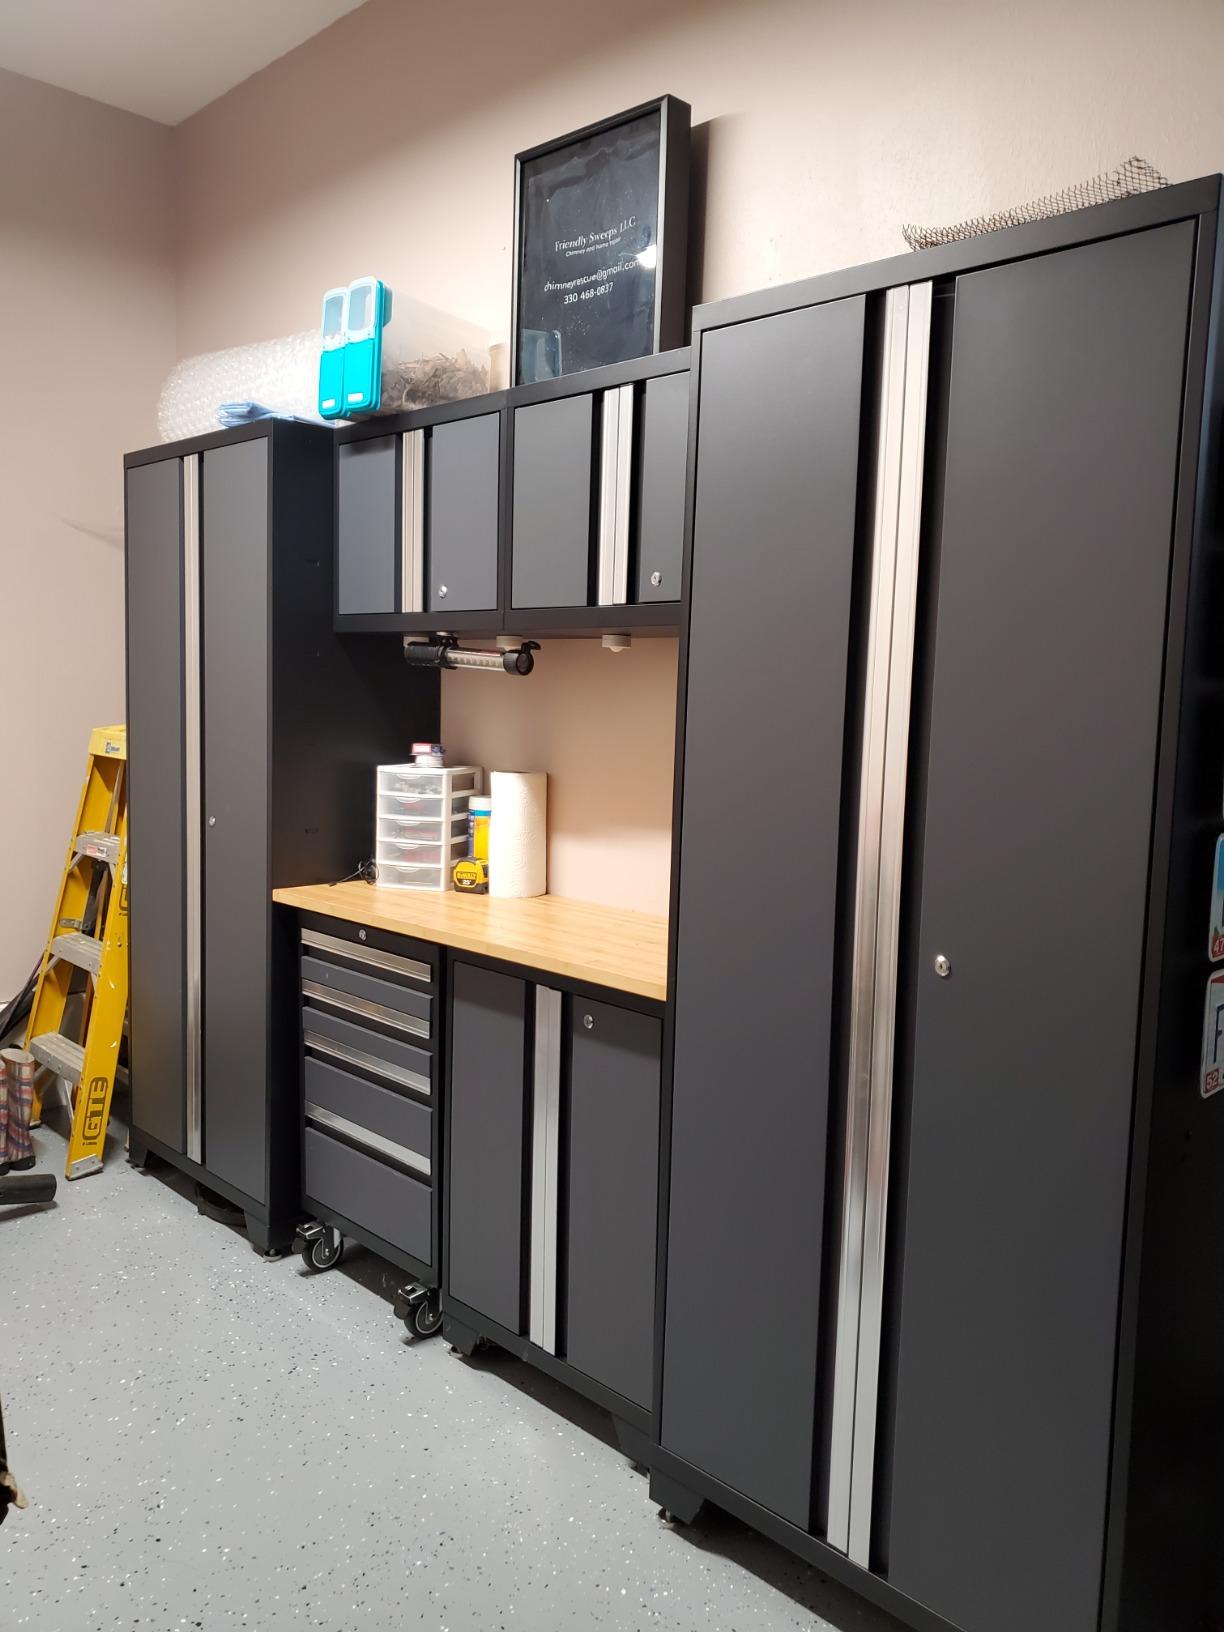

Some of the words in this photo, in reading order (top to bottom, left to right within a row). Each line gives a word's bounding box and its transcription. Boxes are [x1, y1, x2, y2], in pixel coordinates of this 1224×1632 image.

[555, 235, 586, 252] Friendly
[589, 229, 617, 242] Sweeps
[620, 215, 636, 233] LLC
[563, 292, 578, 305] 330
